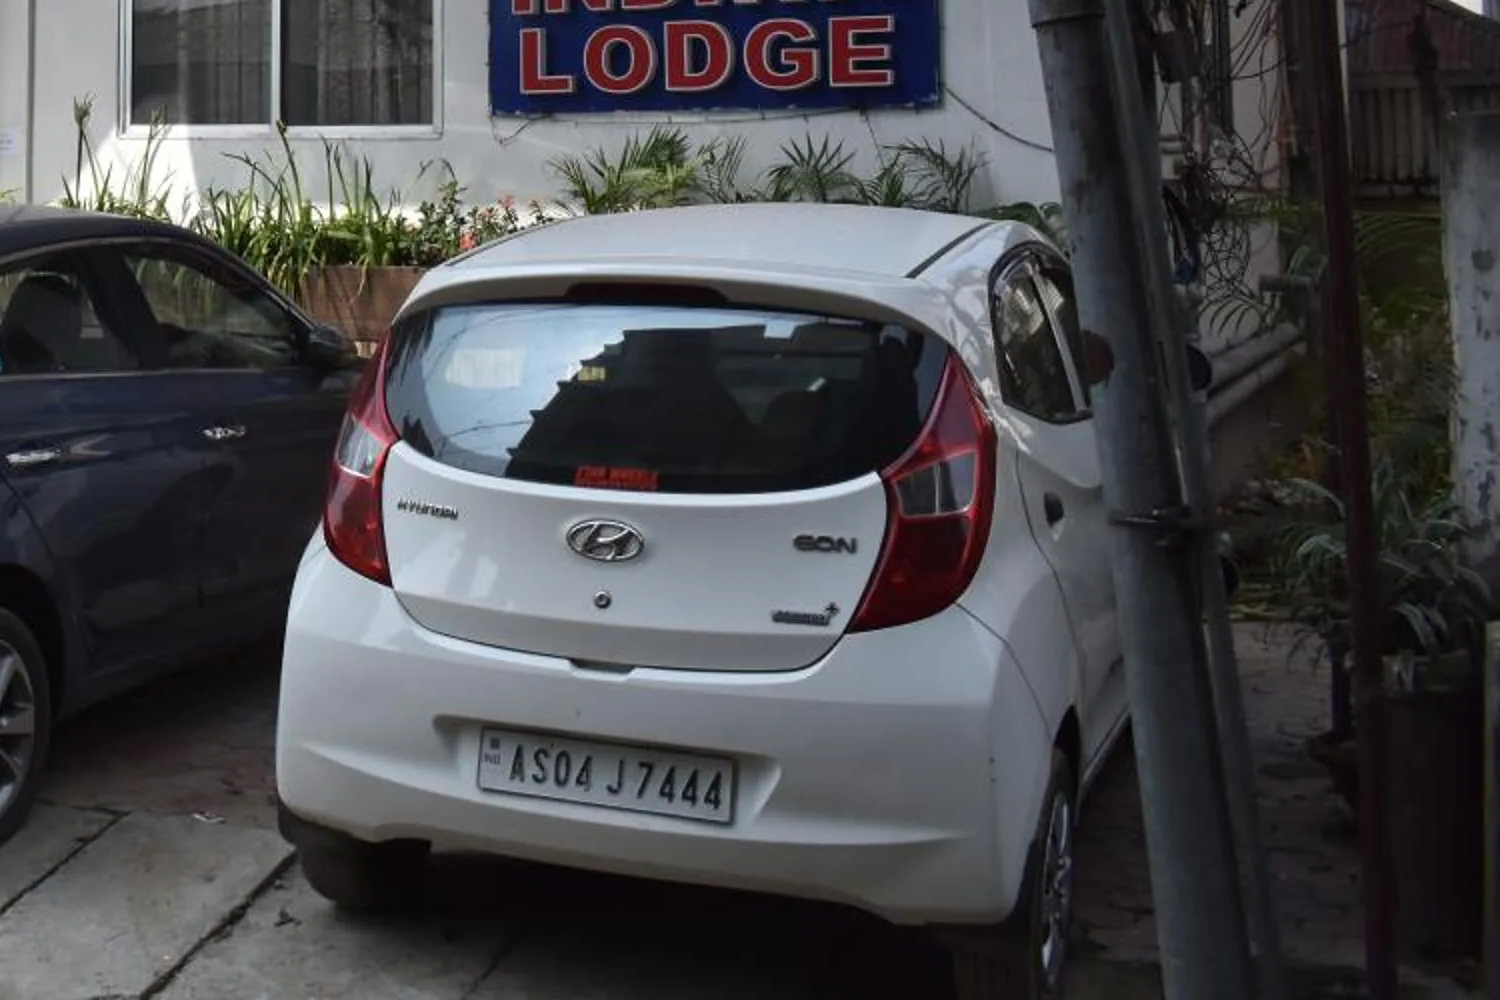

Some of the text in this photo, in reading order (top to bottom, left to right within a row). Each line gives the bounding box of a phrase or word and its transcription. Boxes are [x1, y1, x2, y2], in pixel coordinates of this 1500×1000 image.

[519, 14, 895, 95] LODGE
[793, 534, 858, 554] EON
[509, 744, 594, 793] AS04
